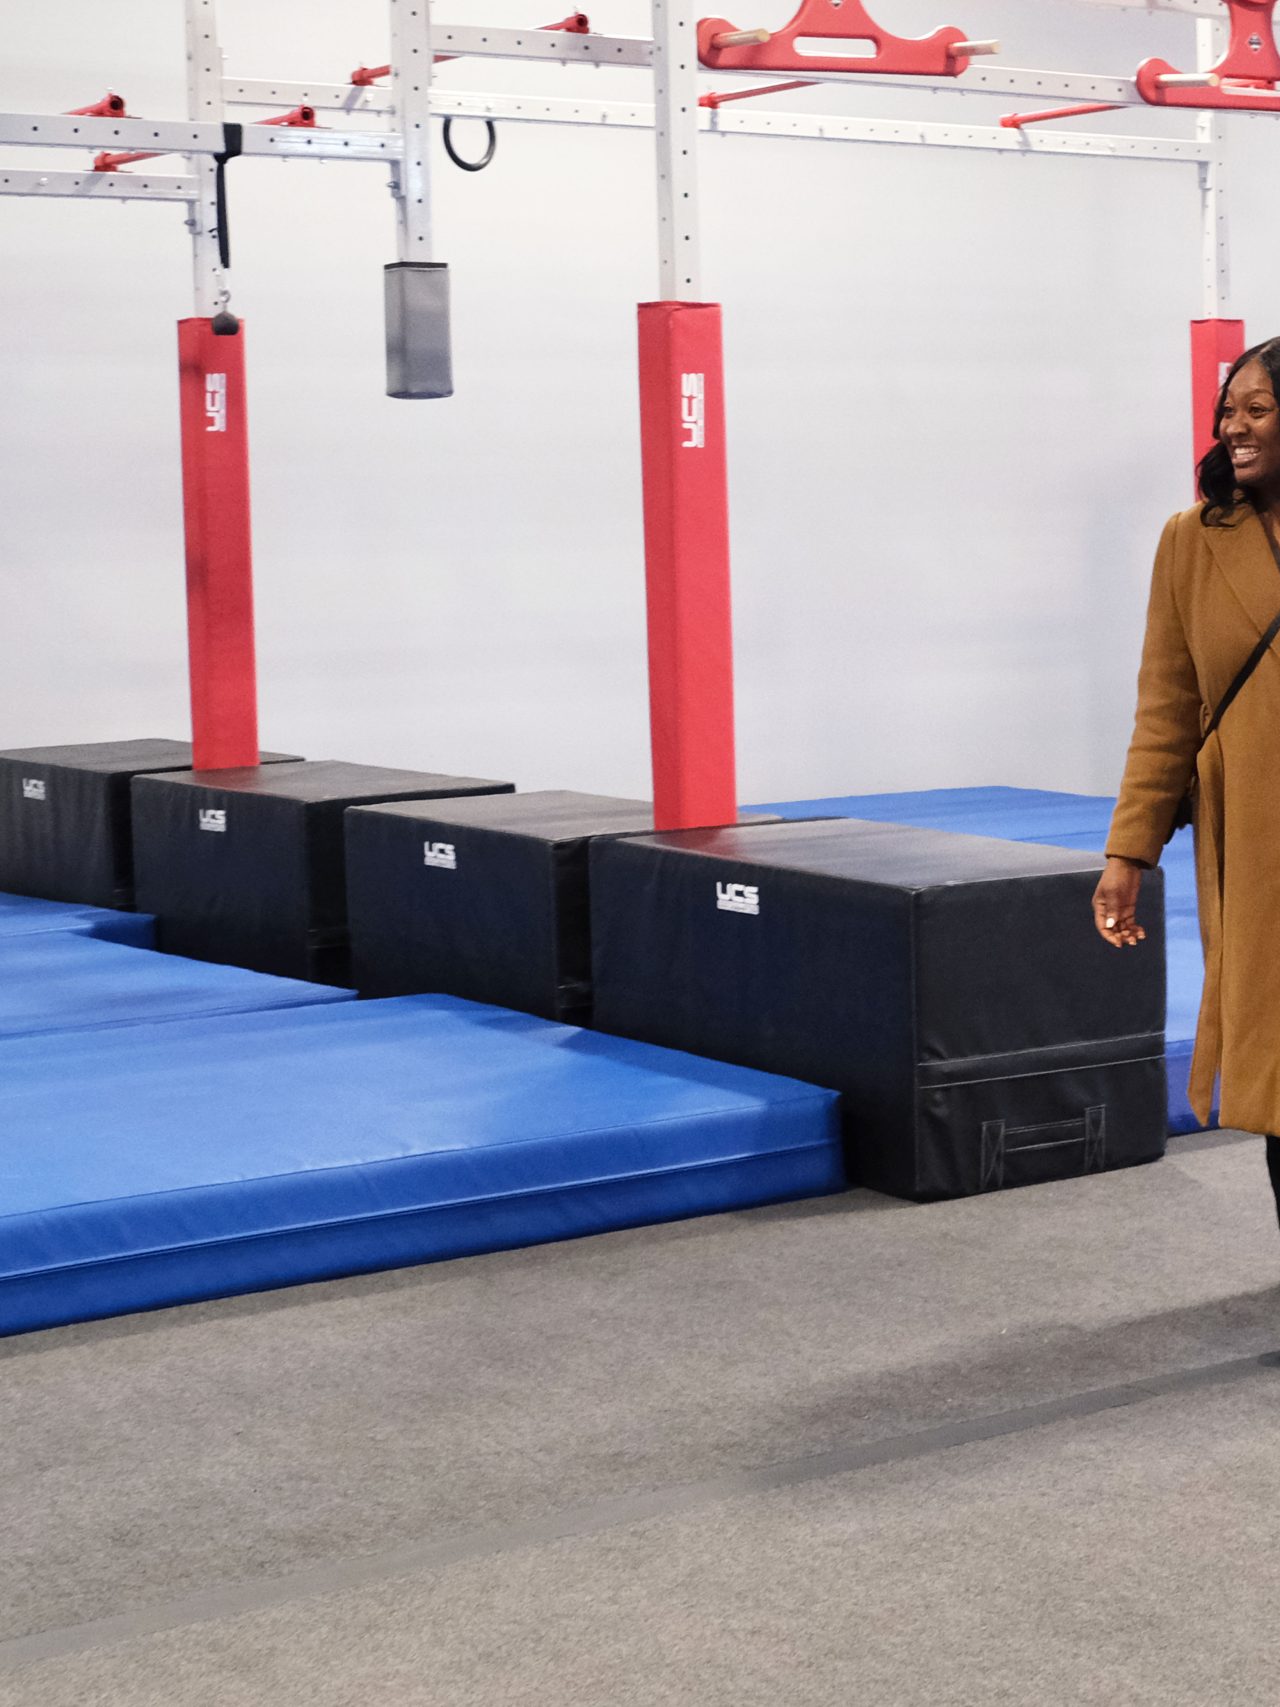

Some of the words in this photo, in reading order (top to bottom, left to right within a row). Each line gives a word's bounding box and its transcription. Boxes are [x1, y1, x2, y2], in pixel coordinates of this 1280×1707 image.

[205, 373, 220, 431] UCS
[681, 372, 698, 448] UCS
[22, 778, 45, 793] UCS
[199, 808, 226, 825] UCS
[424, 841, 456, 860] UCS
[716, 881, 759, 905] UCS
